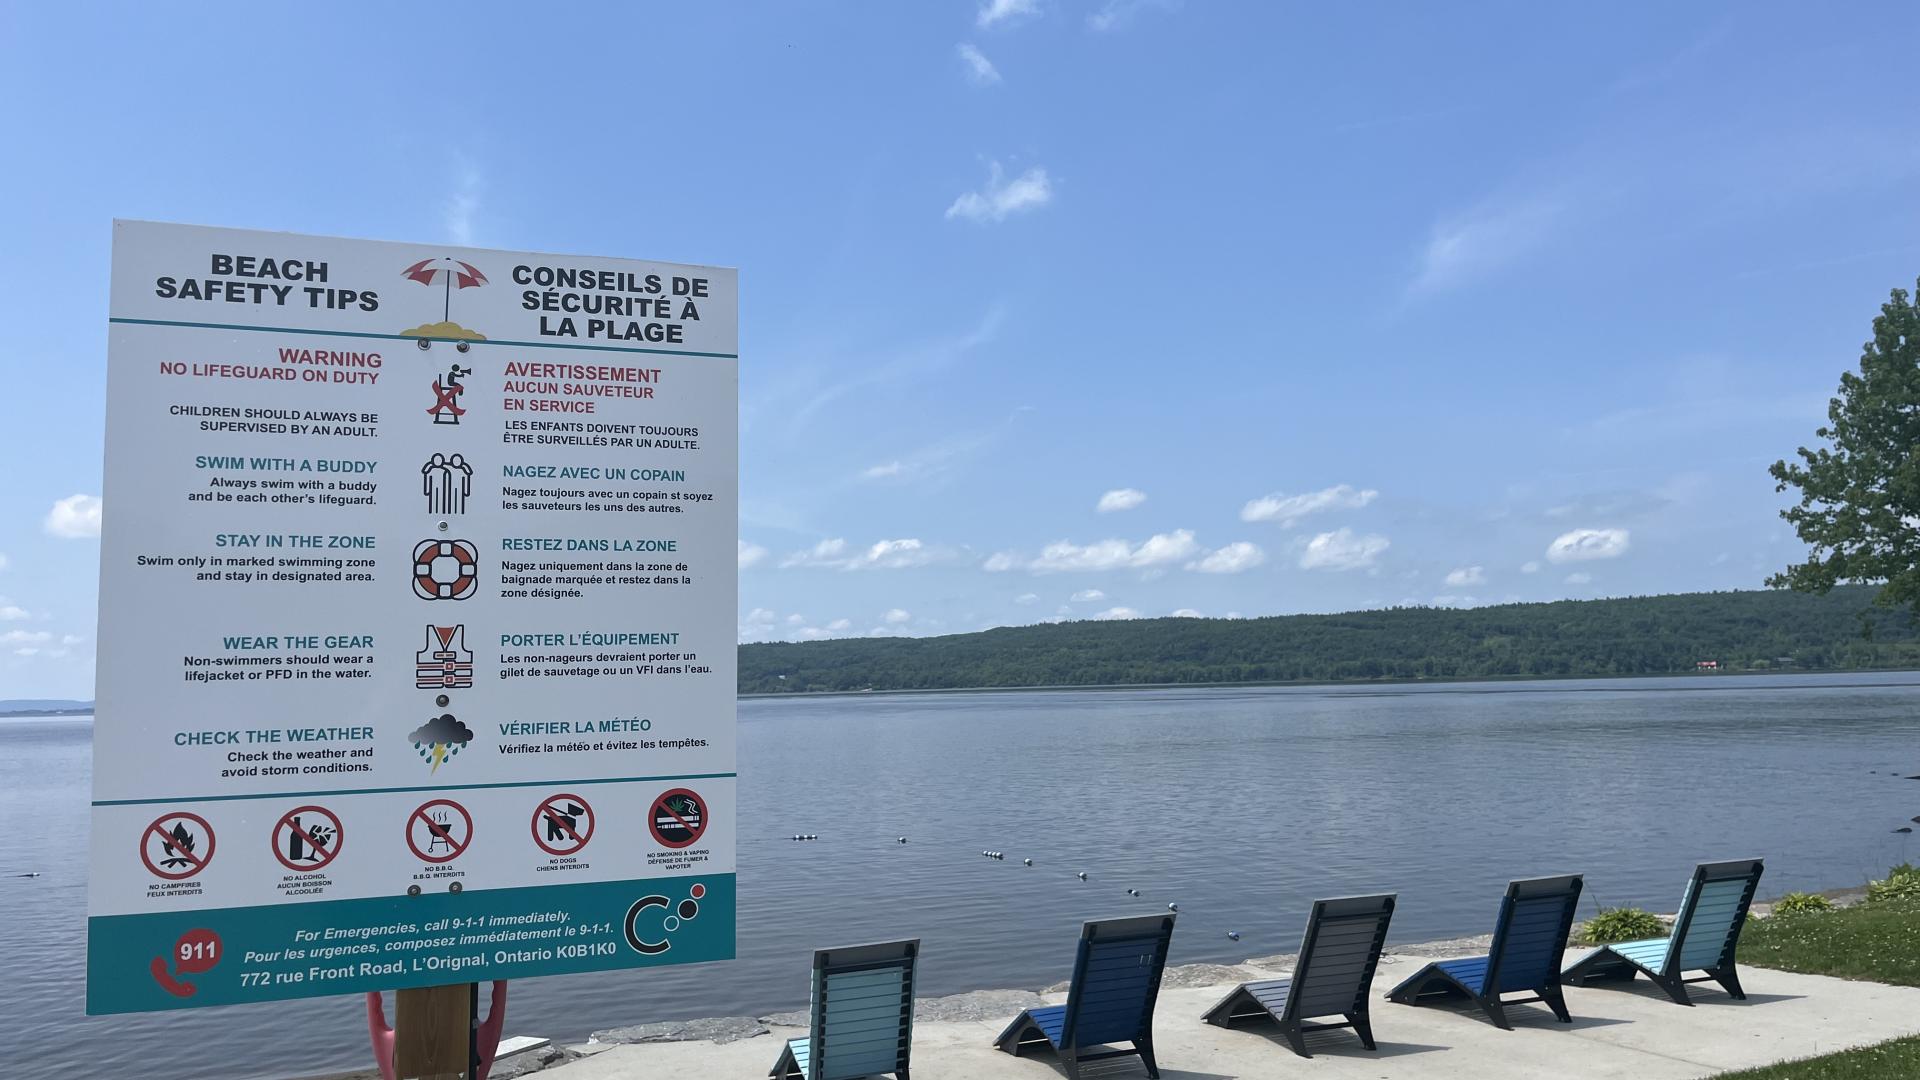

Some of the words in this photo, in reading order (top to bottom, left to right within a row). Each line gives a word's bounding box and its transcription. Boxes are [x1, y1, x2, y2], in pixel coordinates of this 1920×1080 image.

[211, 254, 328, 283] BEACH
[512, 265, 662, 294] CONSEILS
[672, 276, 708, 299] DE
[155, 276, 293, 306] SAFETY
[303, 287, 379, 312] TIPS
[522, 288, 671, 319] SÉCURITÉ
[680, 297, 700, 321] À
[540, 316, 578, 337] LA
[588, 319, 683, 344] PLAGE
[279, 348, 382, 368] WARNING
[160, 362, 187, 375] NO
[193, 363, 297, 380] LIFEGUARD
[302, 369, 327, 382] ON
[333, 370, 379, 384] DUTY
[504, 362, 661, 383] AVERTISSEMENT
[503, 380, 558, 394] AUCUN
[563, 383, 654, 399] SAUVETEUR
[170, 405, 240, 417] CHILDREN
[244, 408, 300, 420] SHOULD
[303, 411, 357, 422] ALWAYS
[361, 413, 378, 423] BE
[504, 398, 524, 410] EN
[529, 399, 594, 413] SERVICE
[200, 420, 286, 433] SUPERVISED
[291, 424, 309, 434] BY
[311, 425, 330, 435] AN
[333, 426, 378, 437] ADULT.
[505, 420, 527, 430] LES
[531, 421, 583, 432] ENFANTS
[587, 423, 636, 434] DOIVENT
[639, 425, 698, 437] TOUJOURS
[503, 431, 534, 444] ÊTRE
[537, 434, 607, 446] SURVEILLÉS
[611, 437, 633, 447] PAR
[636, 438, 651, 448] UN
[654, 439, 700, 450] ADULTE.
[195, 455, 244, 469] SWIM
[250, 457, 294, 471] WITH
[299, 459, 312, 471] A
[317, 459, 377, 473] BUDDY
[503, 465, 556, 478] NAGEZ
[559, 467, 600, 479] AVEC
[605, 468, 625, 480] UN
[630, 469, 684, 482] COPAIN
[210, 477, 257, 490] Always
[261, 479, 294, 489] swim
[298, 479, 324, 489] with
[328, 482, 335, 490] a
[339, 481, 377, 493] buddy
[188, 491, 213, 501] and
[217, 491, 233, 502] be
[236, 492, 267, 502] each
[319, 494, 376, 507] lifeguard.
[503, 486, 536, 498] Nagez
[539, 488, 585, 499] toujours
[588, 490, 613, 498] avec
[616, 491, 629, 499] un
[632, 490, 668, 501] copain
[683, 493, 713, 502] soyez
[215, 534, 261, 547] STAY
[266, 535, 282, 547] IN
[288, 535, 323, 548] THE
[328, 535, 375, 549] ZONE
[502, 538, 562, 550] RESTEZ
[567, 539, 609, 551] DANS
[614, 539, 633, 551] LA
[636, 540, 676, 552] ZONE
[137, 555, 173, 565] Swim
[177, 556, 206, 568] only
[210, 556, 222, 565] in
[226, 556, 274, 566] marked
[278, 557, 343, 569] swimming
[346, 559, 375, 567] zone
[223, 636, 278, 649] WEAR
[283, 636, 319, 649] THE
[324, 635, 373, 648] GEAR
[501, 634, 564, 647] PORTER
[184, 655, 282, 666] Non-swimmers
[286, 654, 329, 664] should
[333, 656, 363, 664] wear
[185, 670, 244, 683] lifejacket
[266, 669, 292, 679] PFD
[296, 669, 308, 679] in
[311, 668, 331, 678] the
[335, 669, 371, 678] water.
[499, 720, 570, 735] VÉRIFIER
[575, 721, 595, 733] LA
[599, 716, 651, 732] MÉTÉO
[174, 731, 240, 746] CHECK
[245, 729, 281, 743] THE
[286, 727, 373, 742] WEATHER
[227, 751, 268, 762] Check
[272, 750, 293, 760] the
[296, 748, 347, 759] weather
[350, 747, 373, 757] and
[221, 766, 257, 777] avoid
[261, 766, 298, 775] storm
[302, 762, 372, 774] conditions.
[161, 881, 201, 889] CAMPFIRES
[294, 873, 326, 881] ALCOHOL
[302, 880, 332, 888] BOISSON
[295, 930, 321, 942] For
[324, 922, 419, 939] Emergencies,
[424, 918, 449, 931] call
[452, 916, 484, 929] 9-1-1
[489, 910, 570, 926] immediately.
[180, 941, 215, 960] 911
[244, 951, 281, 963] Pour
[284, 948, 305, 960] les
[309, 943, 379, 959] urgences,
[384, 937, 456, 951] composez
[459, 927, 561, 944] immédiatement
[564, 925, 576, 936] le
[579, 922, 613, 935] 9-1-1.
[240, 971, 270, 987] 772
[276, 972, 304, 984] rue
[309, 965, 354, 981] Front
[360, 959, 407, 976] Road,
[494, 947, 552, 964] Ontario
